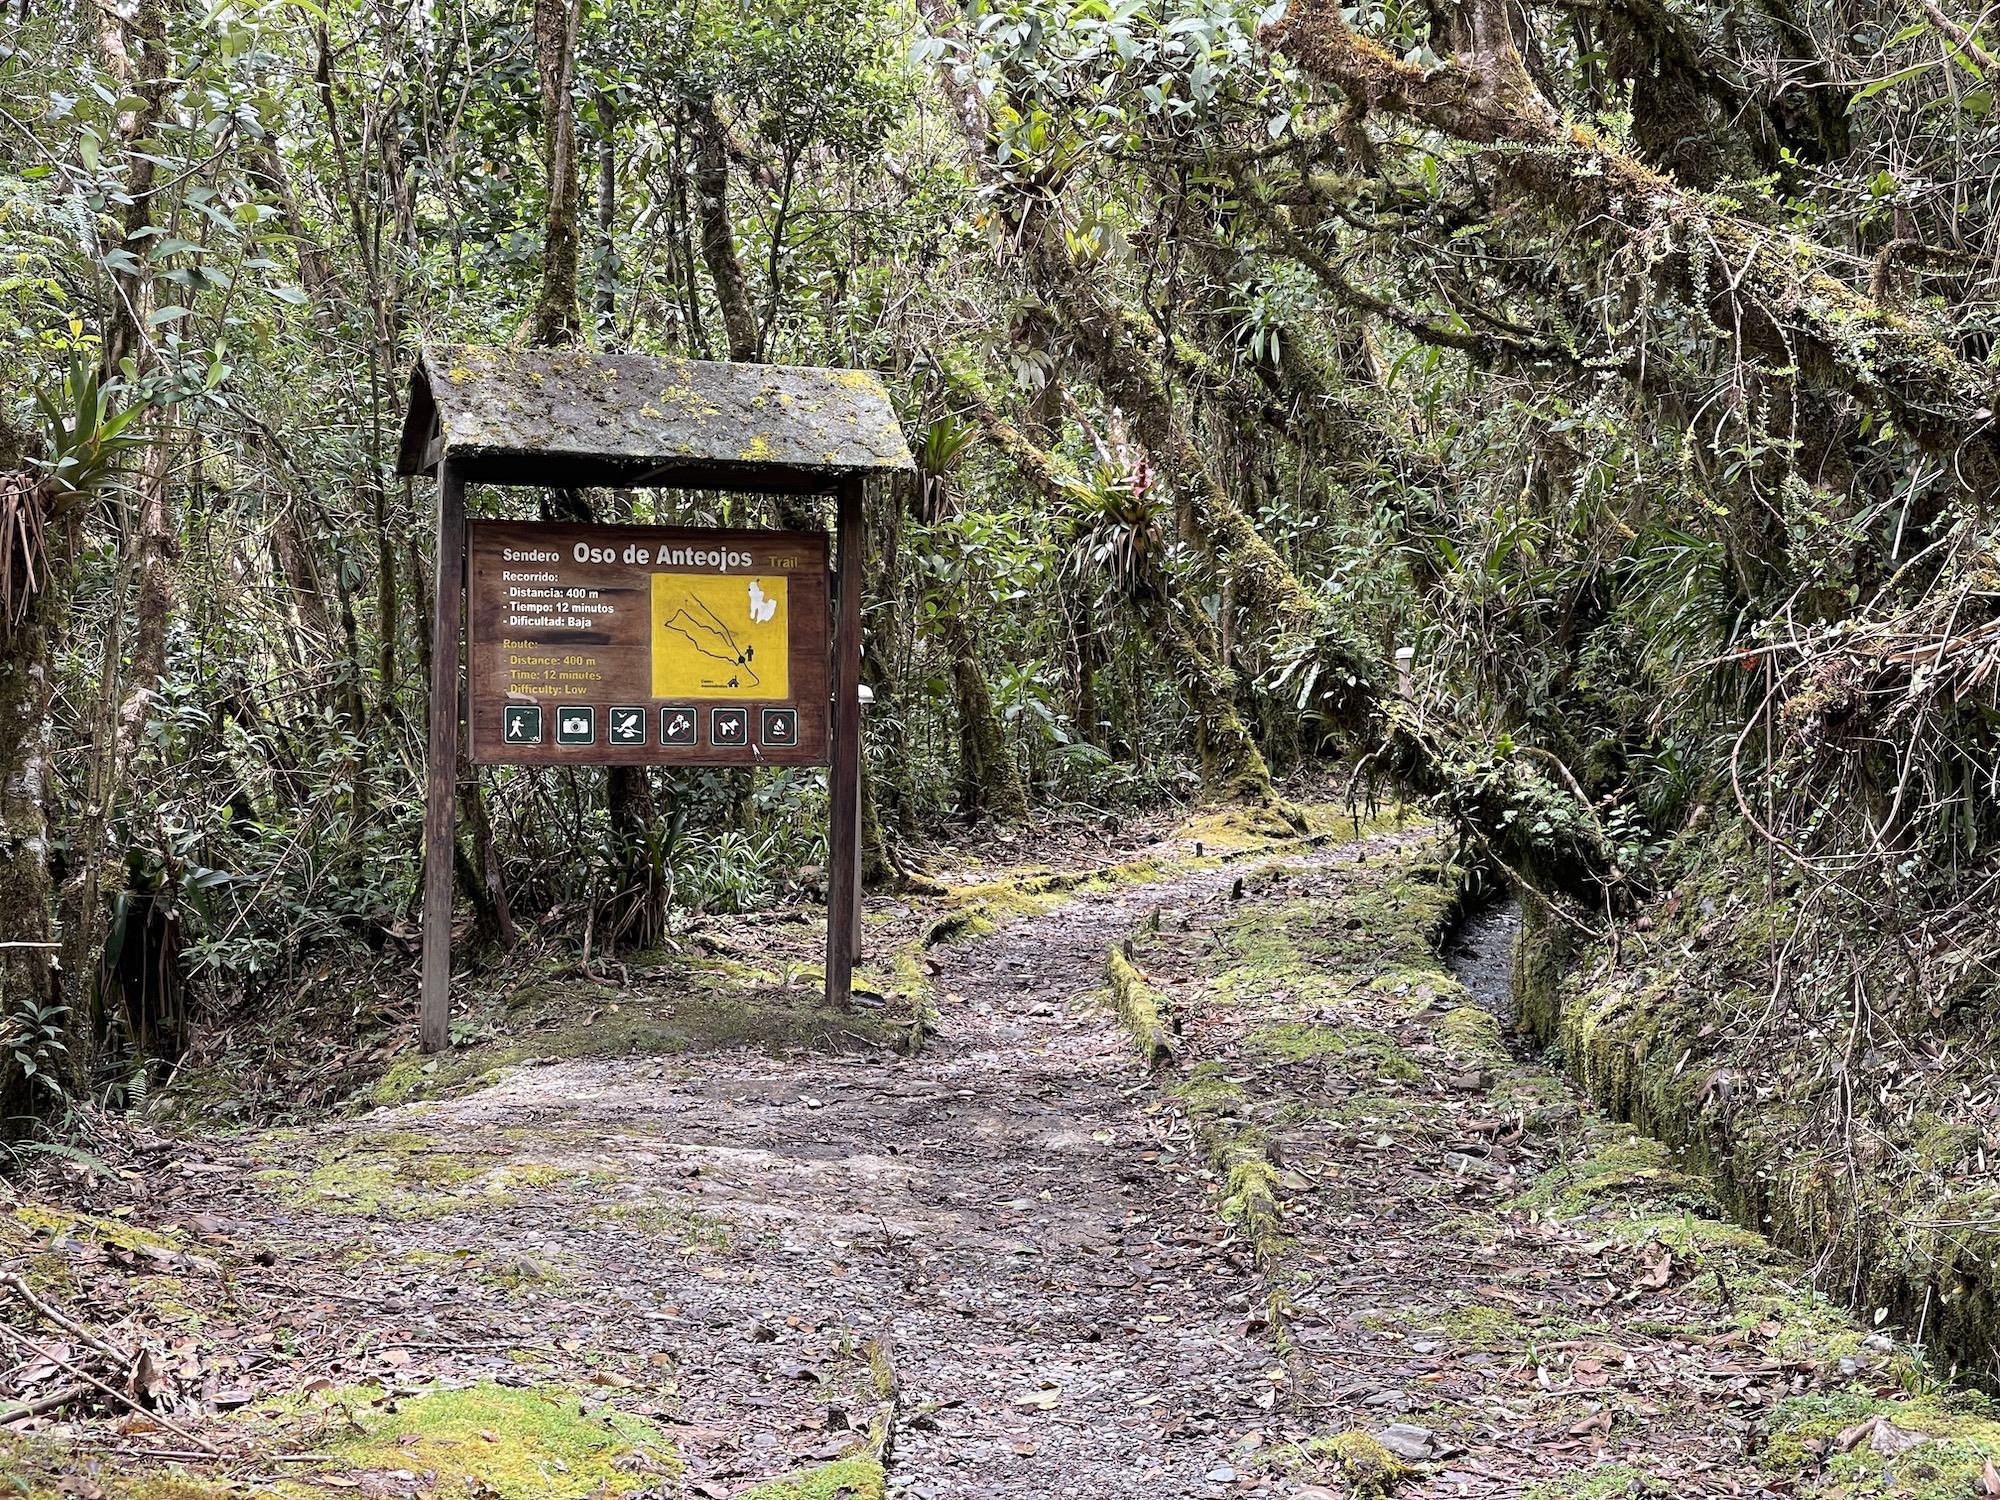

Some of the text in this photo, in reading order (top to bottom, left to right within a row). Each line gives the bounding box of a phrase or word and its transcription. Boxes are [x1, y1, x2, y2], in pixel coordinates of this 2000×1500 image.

[502, 542, 798, 572] Sendero Oso de Anteojos Trail
[502, 571, 559, 582] Recorrido:
[509, 587, 564, 598] Distancia:
[566, 588, 586, 598] 400
[588, 591, 599, 599] m
[509, 601, 553, 614] Tiempo:
[555, 602, 570, 613] 12
[571, 603, 614, 613] minutos
[509, 616, 565, 627] Dificultad:
[567, 617, 592, 629] Baja
[503, 639, 539, 649] Route:
[510, 655, 561, 666] Distance:
[563, 656, 583, 666] 400
[586, 658, 596, 666] m
[510, 670, 540, 680] Time:
[543, 670, 557, 680] 12
[559, 671, 602, 681] minutes
[510, 684, 562, 696] Difficulty:
[565, 686, 587, 695] Low
